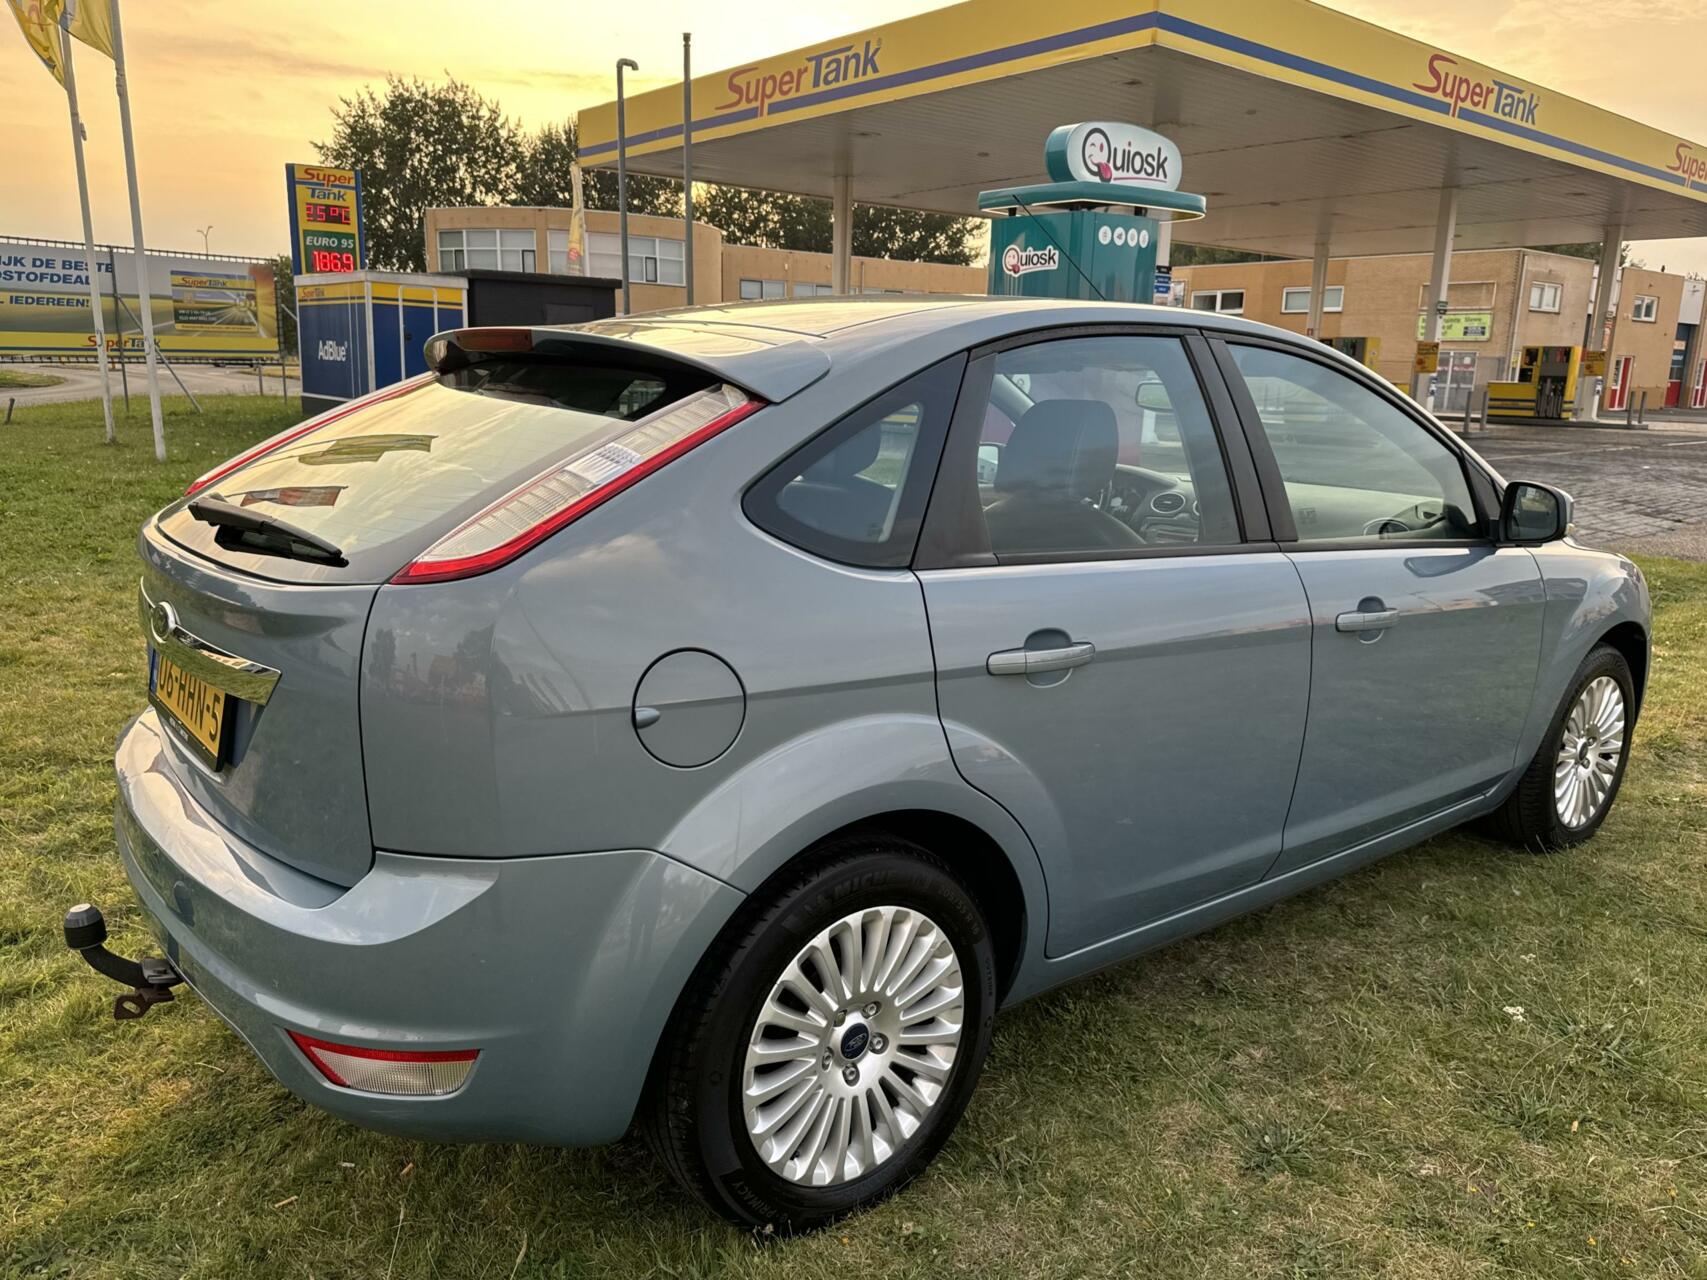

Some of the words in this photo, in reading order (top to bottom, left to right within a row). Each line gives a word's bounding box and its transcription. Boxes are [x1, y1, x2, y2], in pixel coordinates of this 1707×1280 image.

[714, 38, 882, 118] SuperTank
[1412, 54, 1540, 126] SuperTank
[1082, 127, 1168, 184] Quiosk
[298, 168, 354, 188] Super
[306, 186, 346, 202] Tank
[306, 236, 337, 247] EURO
[341, 238, 354, 249] 95
[32, 258, 56, 269] DE
[1004, 246, 1057, 274] Quiosk
[10, 295, 90, 308] IEDEREEN!
[158, 655, 222, 743] 06-HHN-5
